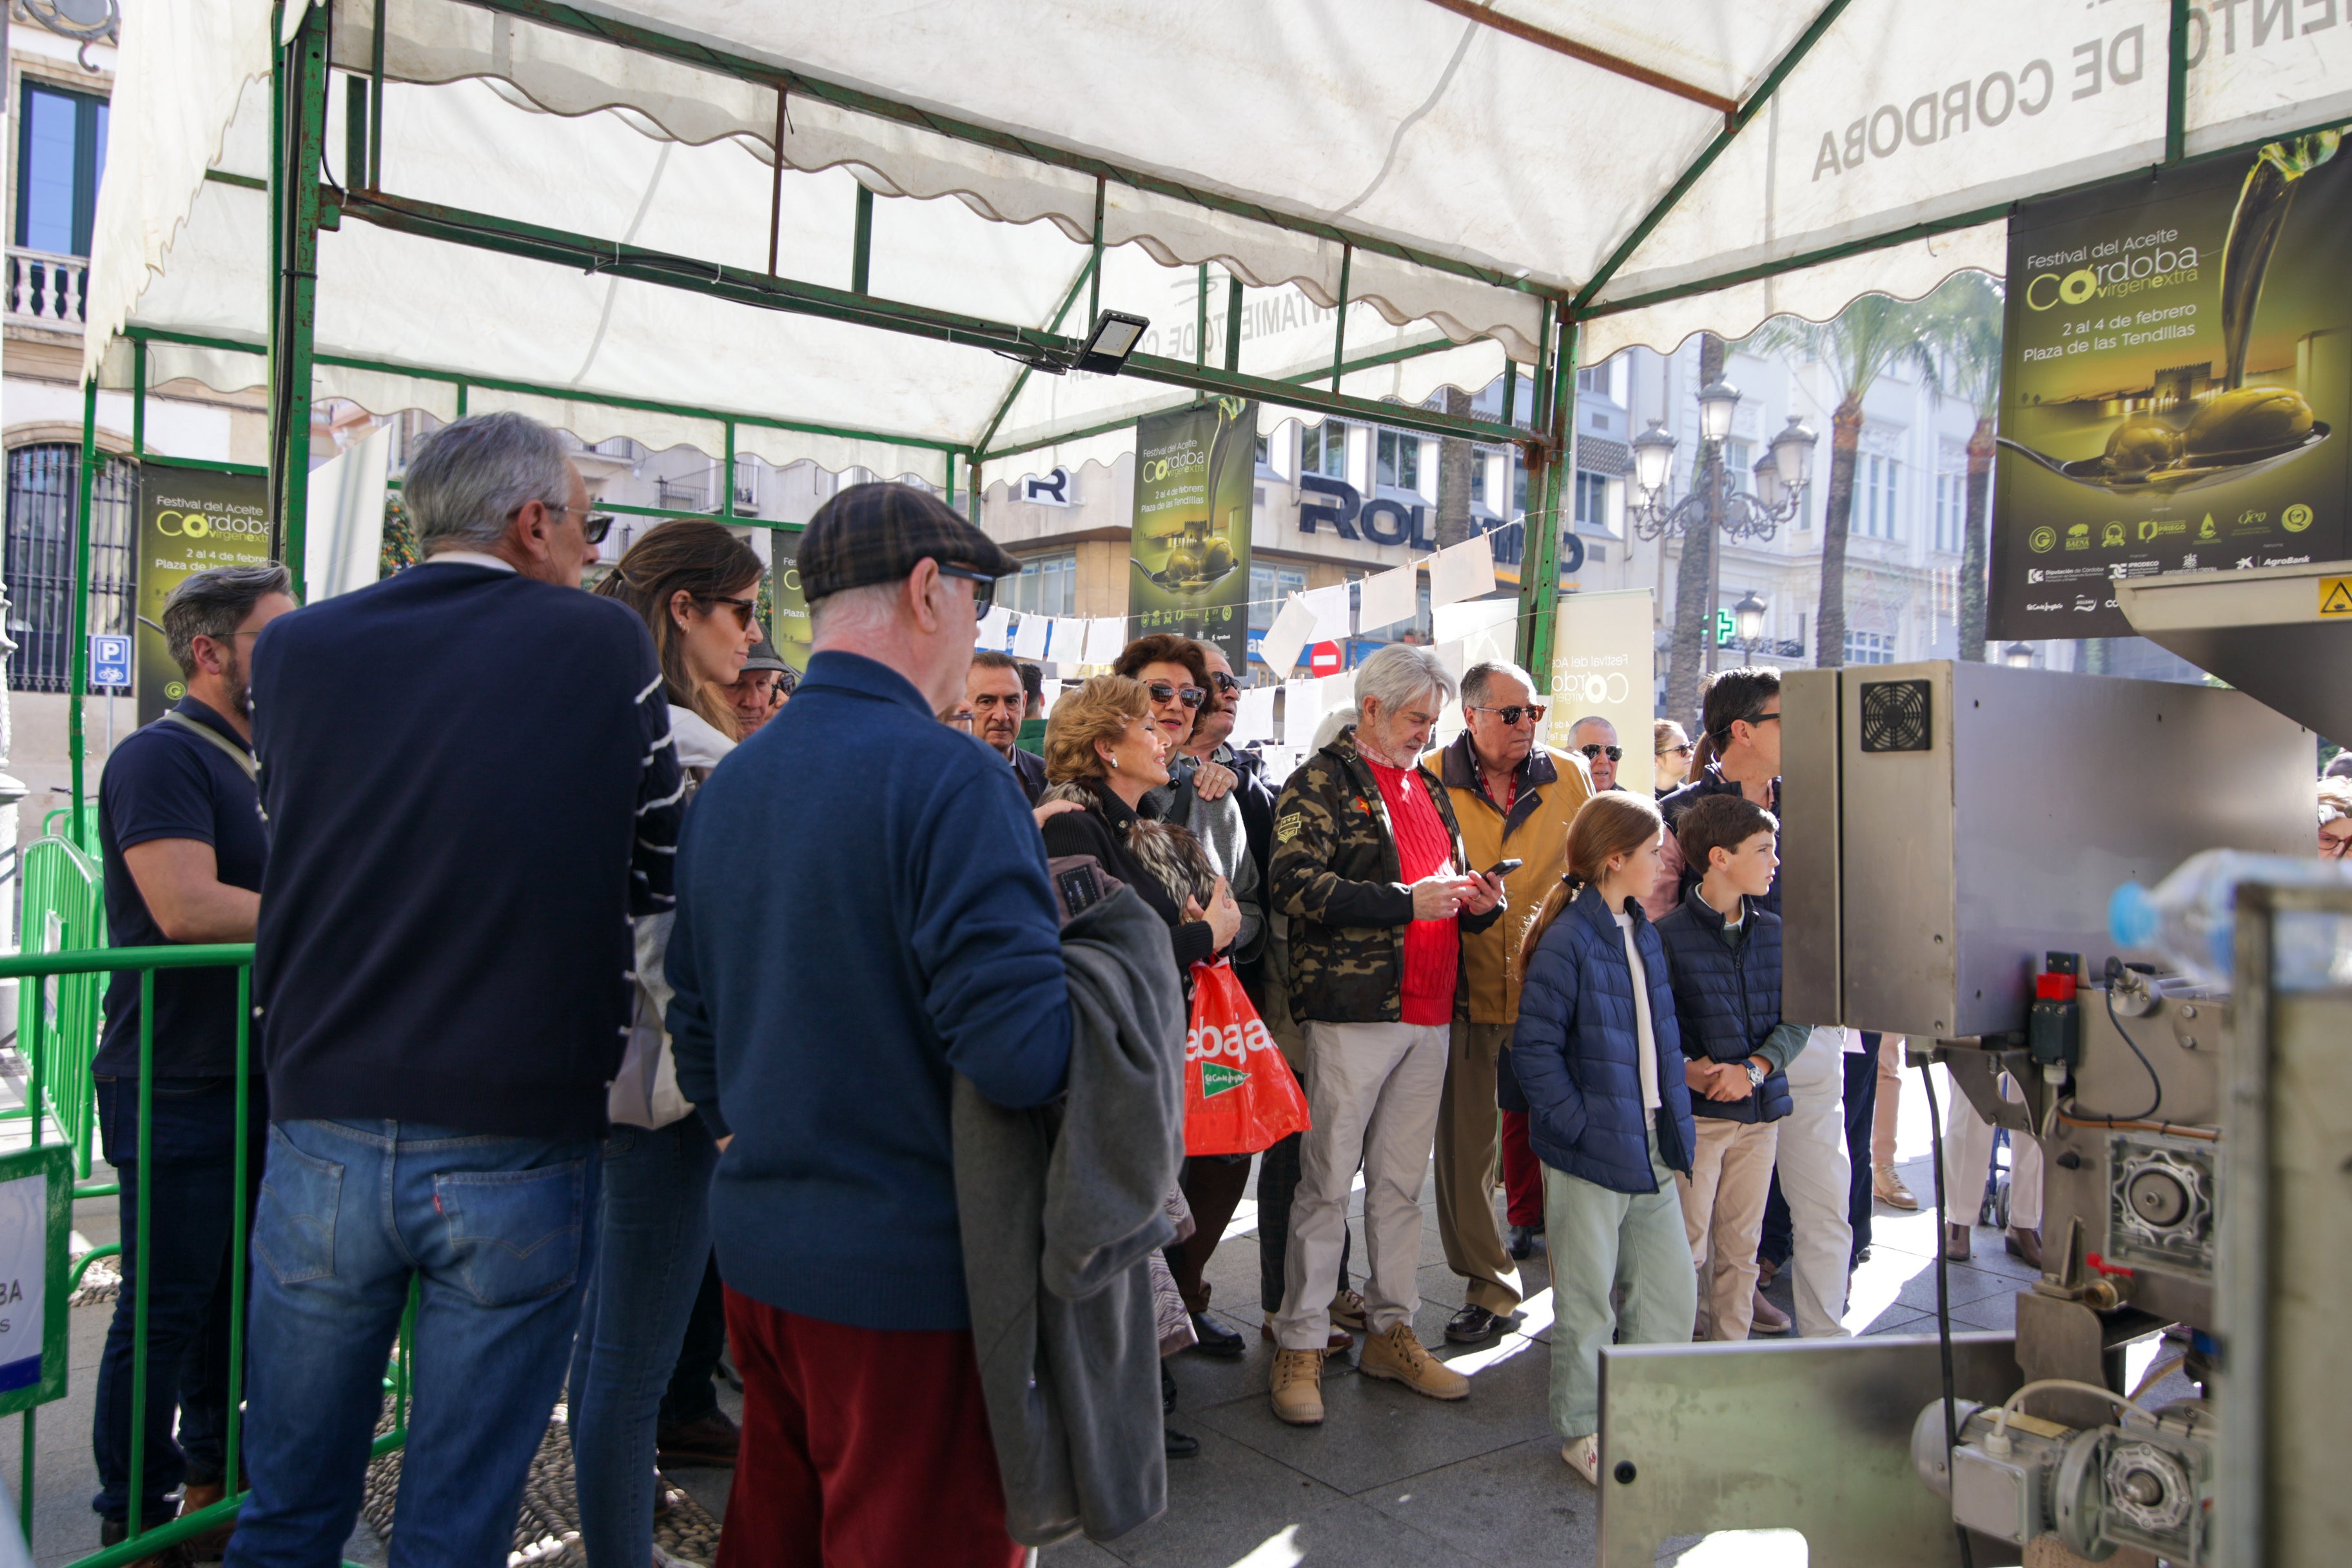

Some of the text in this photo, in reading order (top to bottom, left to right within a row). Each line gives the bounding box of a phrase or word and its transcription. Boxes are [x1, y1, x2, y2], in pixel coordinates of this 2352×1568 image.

[2027, 228, 2179, 270] Festival del Aceite
[2097, 268, 2199, 299] virgenextra
[2063, 304, 2197, 337] 2 al 4 de febrero
[2023, 323, 2196, 362] Plaza de las Tendillas
[1143, 439, 1197, 458] Festival del Aceite
[1171, 487, 1179, 495] de
[1179, 485, 1204, 494] febrero
[156, 495, 264, 516] Festival del Aceite
[1141, 504, 1156, 513] Plaza
[1157, 502, 1165, 511] de
[1173, 496, 1204, 505] Tendillas
[186, 548, 193, 558] 2
[195, 549, 206, 559] al
[209, 551, 216, 559] 4
[219, 552, 234, 562] de
[2263, 555, 2311, 567] AgroBank
[155, 558, 186, 571] Plaza
[190, 561, 206, 571] de
[783, 609, 805, 618] Plaza
[103, 644, 119, 660] P
